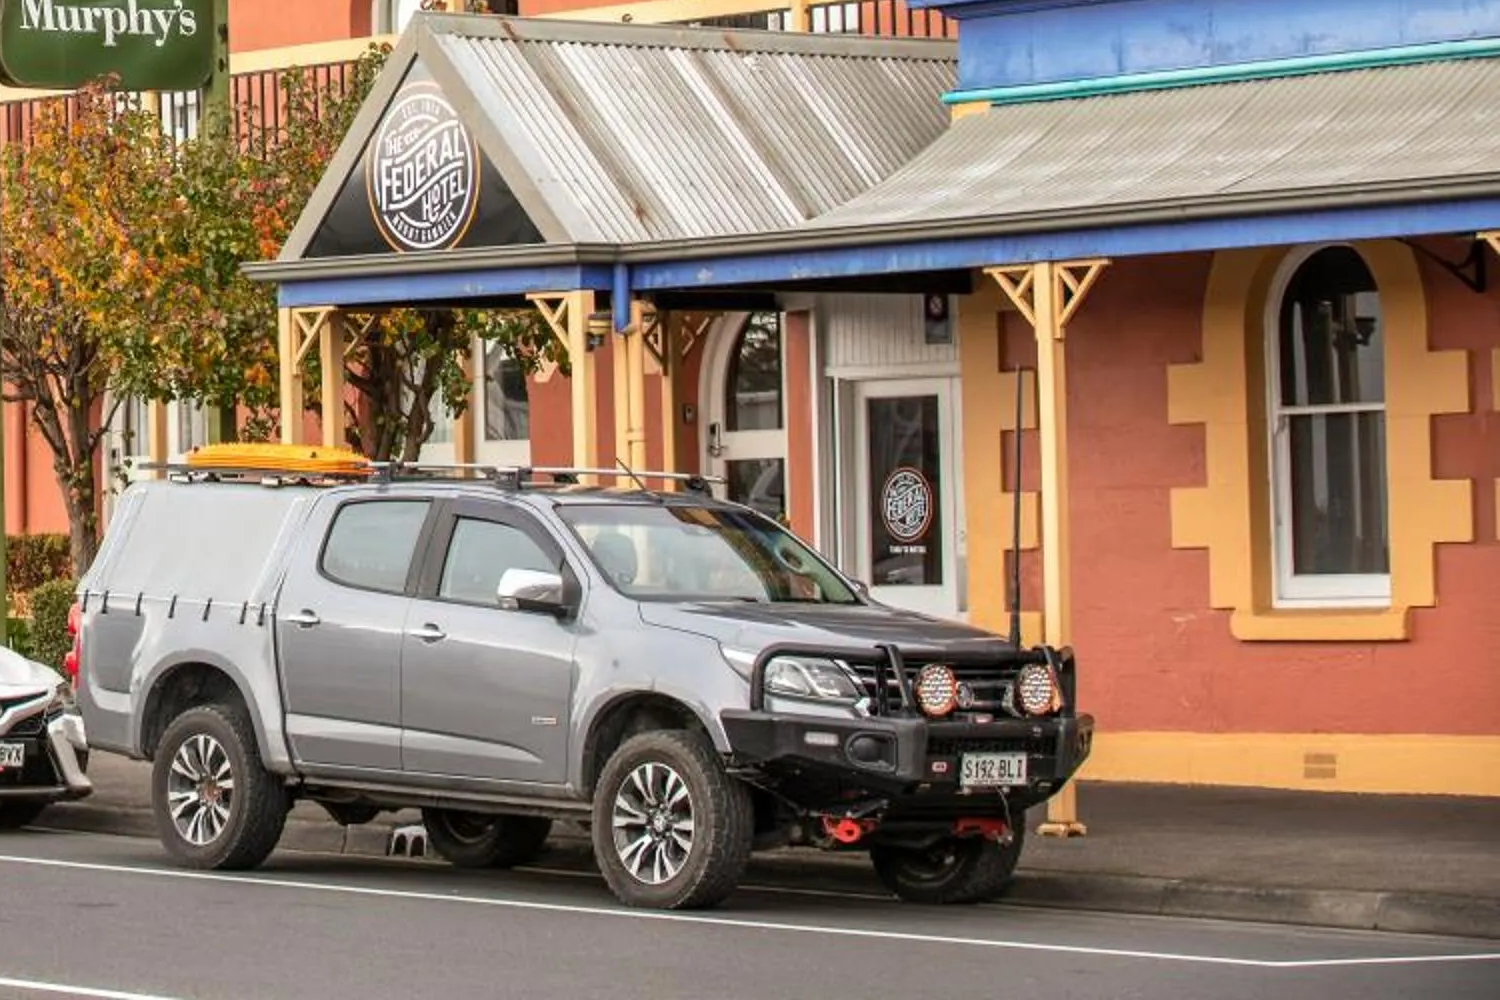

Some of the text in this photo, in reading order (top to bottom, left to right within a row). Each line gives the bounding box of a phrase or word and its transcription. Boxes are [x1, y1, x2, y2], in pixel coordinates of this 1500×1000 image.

[380, 123, 465, 211] FEDERAL
[385, 130, 404, 156] THE
[421, 168, 467, 223] HOTEL
